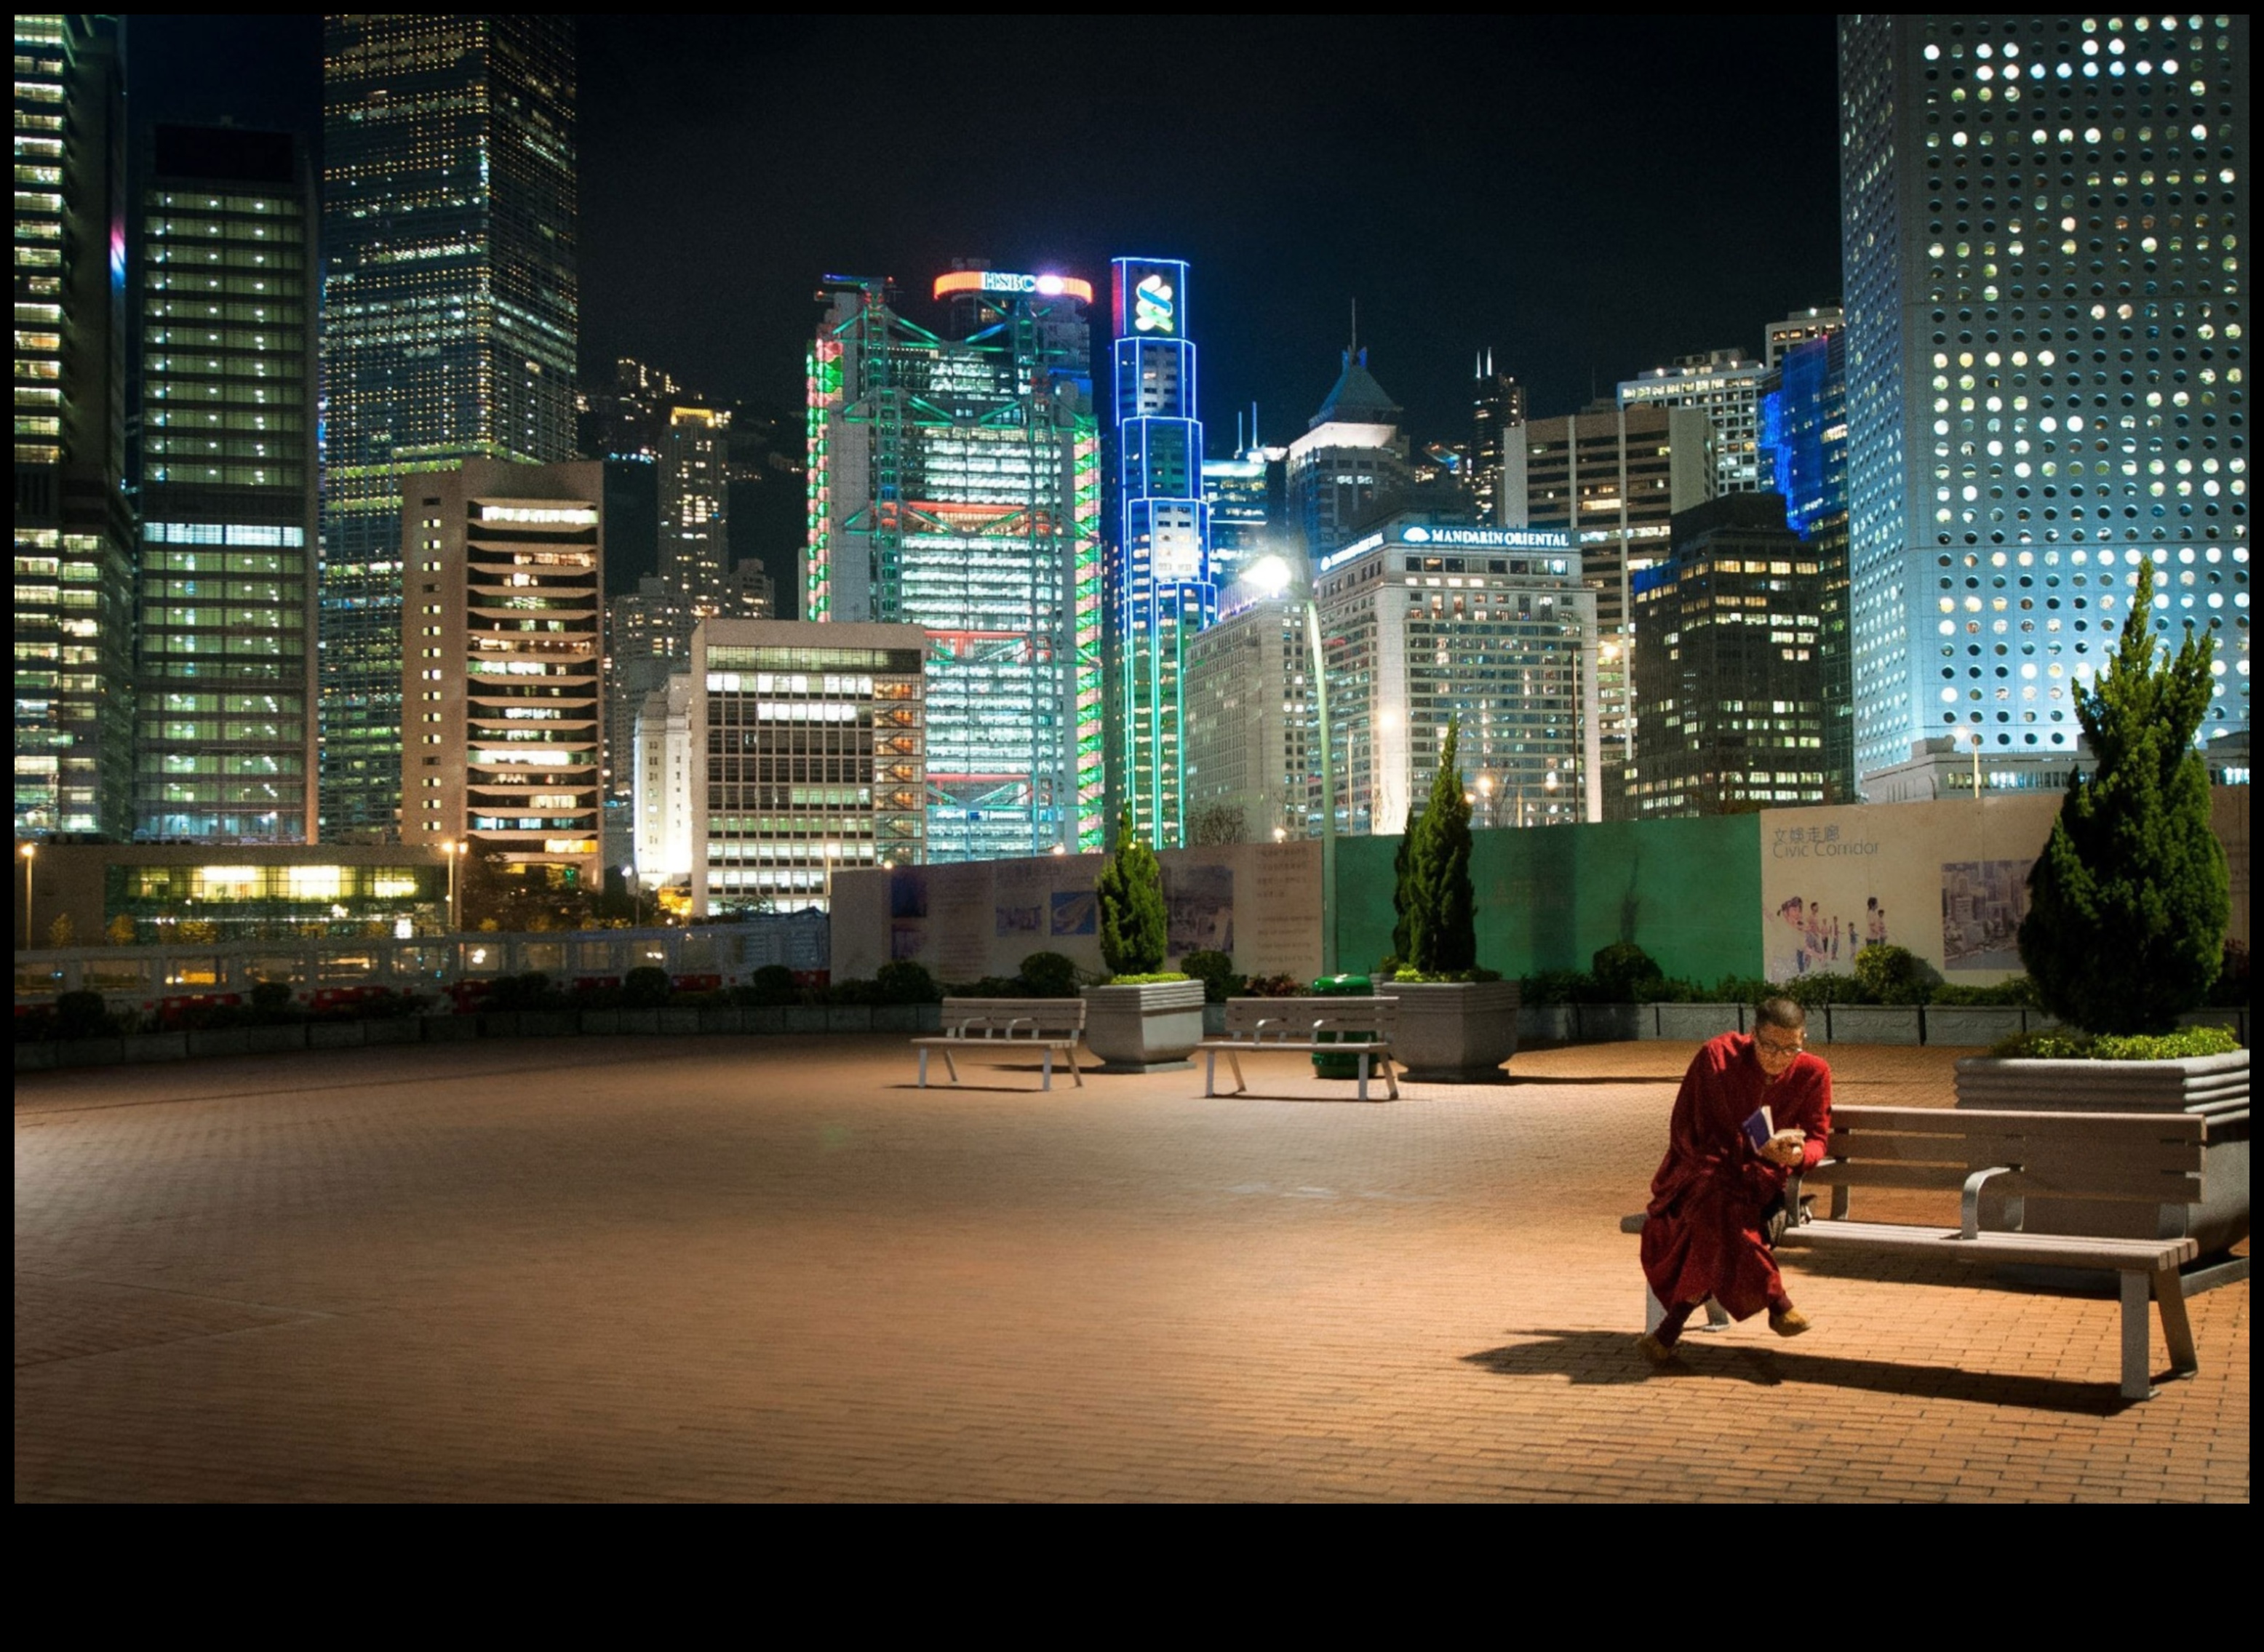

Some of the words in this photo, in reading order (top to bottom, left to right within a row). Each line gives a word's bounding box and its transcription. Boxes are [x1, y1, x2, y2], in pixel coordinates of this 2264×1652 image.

[982, 272, 1035, 292] HSBC
[1432, 530, 1503, 544] MANDARIN
[1504, 532, 1569, 546] ORIENTAL
[1773, 842, 1809, 858] Civic
[1814, 839, 1879, 857] Corridor
